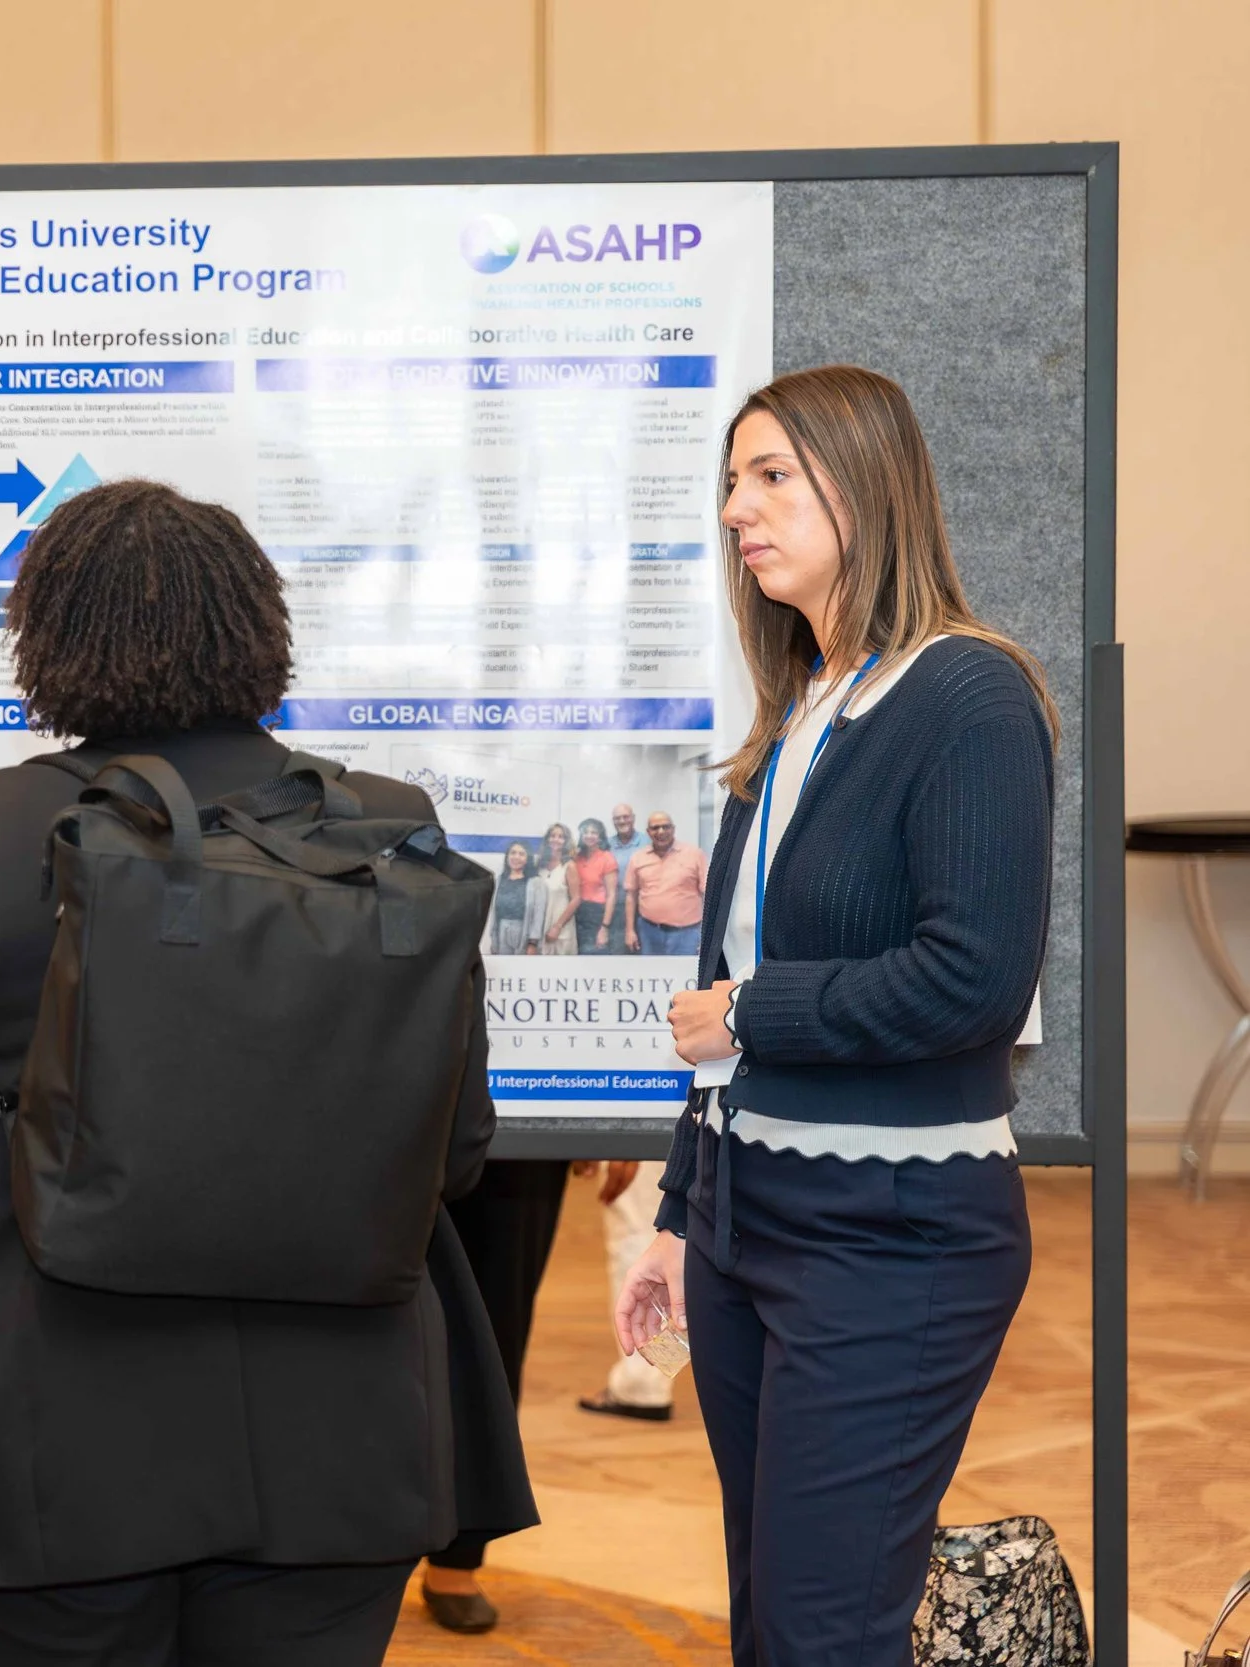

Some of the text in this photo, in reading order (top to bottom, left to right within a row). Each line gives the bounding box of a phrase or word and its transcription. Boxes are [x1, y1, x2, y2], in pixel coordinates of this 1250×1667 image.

[31, 217, 211, 253] University
[526, 223, 703, 263] ASAHP
[0, 264, 178, 295] Education
[193, 262, 345, 300] Program
[585, 282, 604, 293] OF
[609, 281, 675, 293] SCHOOLS
[26, 330, 44, 348] in
[52, 328, 236, 351] Interprofessional
[564, 324, 635, 342] Health
[643, 323, 694, 341] Care
[8, 368, 164, 389] INTEGRATION
[517, 363, 660, 382] INNOVATION
[349, 704, 618, 724] GLOBAL ENGAGEMENT
[454, 777, 485, 789] SOY
[454, 791, 530, 806] BILLIKENO
[486, 977, 699, 993] THE UNIVERSITY O
[486, 998, 600, 1023] NOTRE
[497, 1075, 608, 1090] Interprofessional
[613, 1075, 678, 1089] Education
